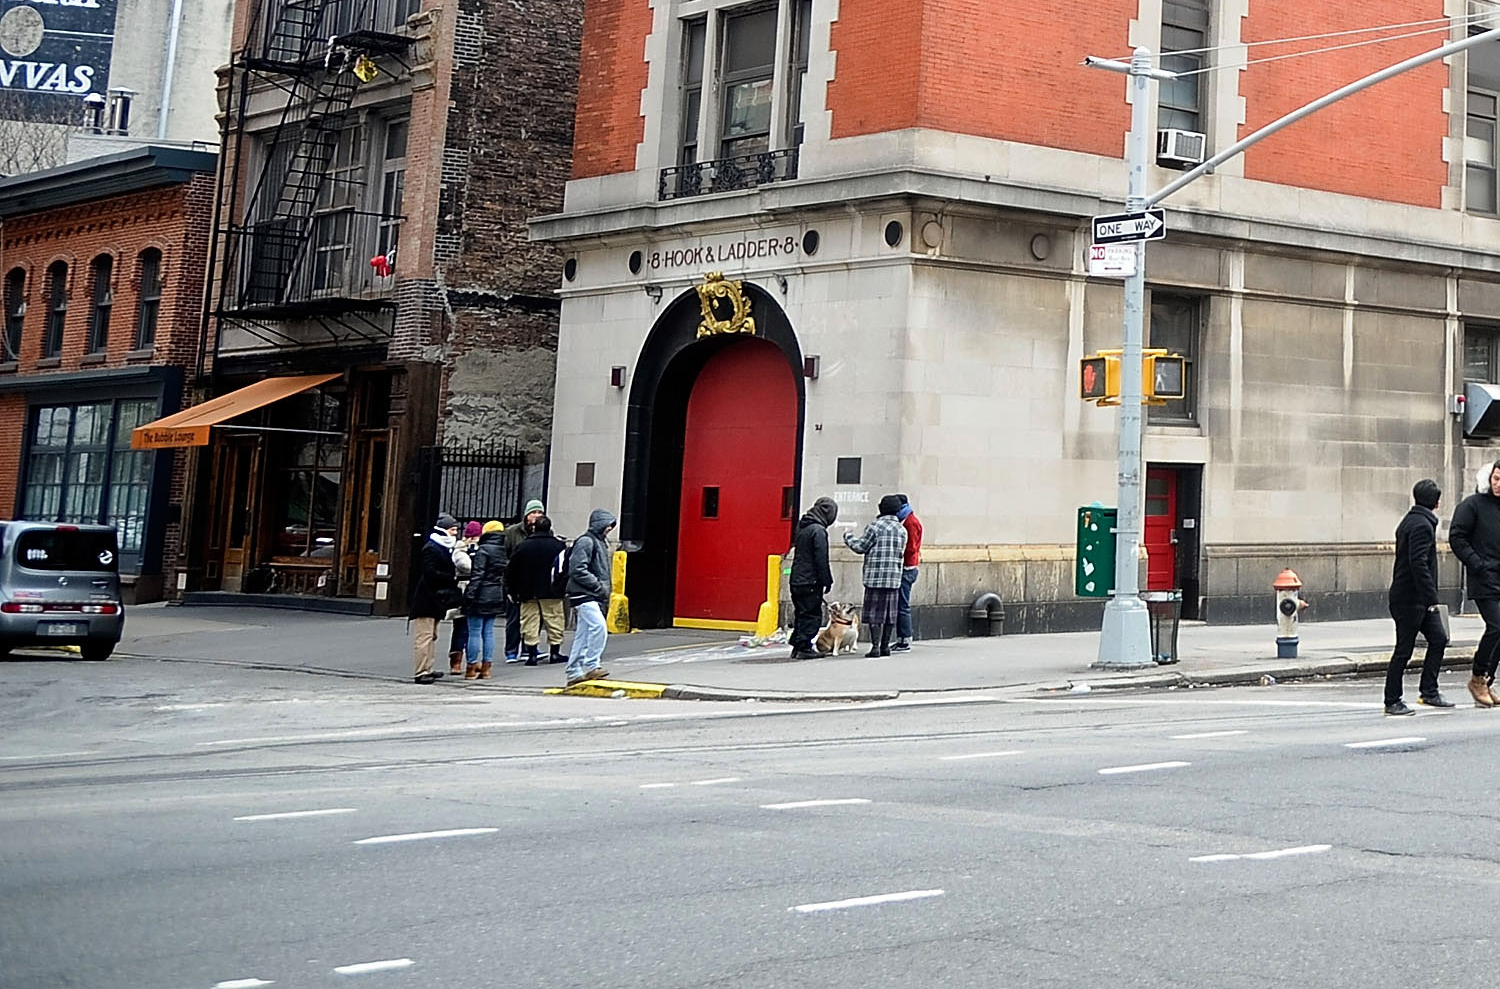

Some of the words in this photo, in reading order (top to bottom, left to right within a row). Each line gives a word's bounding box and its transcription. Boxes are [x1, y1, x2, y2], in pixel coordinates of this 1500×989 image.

[1099, 223, 1122, 236] ONE
[1135, 219, 1156, 231] WAY
[664, 248, 703, 268] HOOK
[706, 245, 715, 264] &
[718, 238, 779, 262] LADDER
[1092, 247, 1105, 259] NO
[834, 491, 869, 503] ENTRANCE
